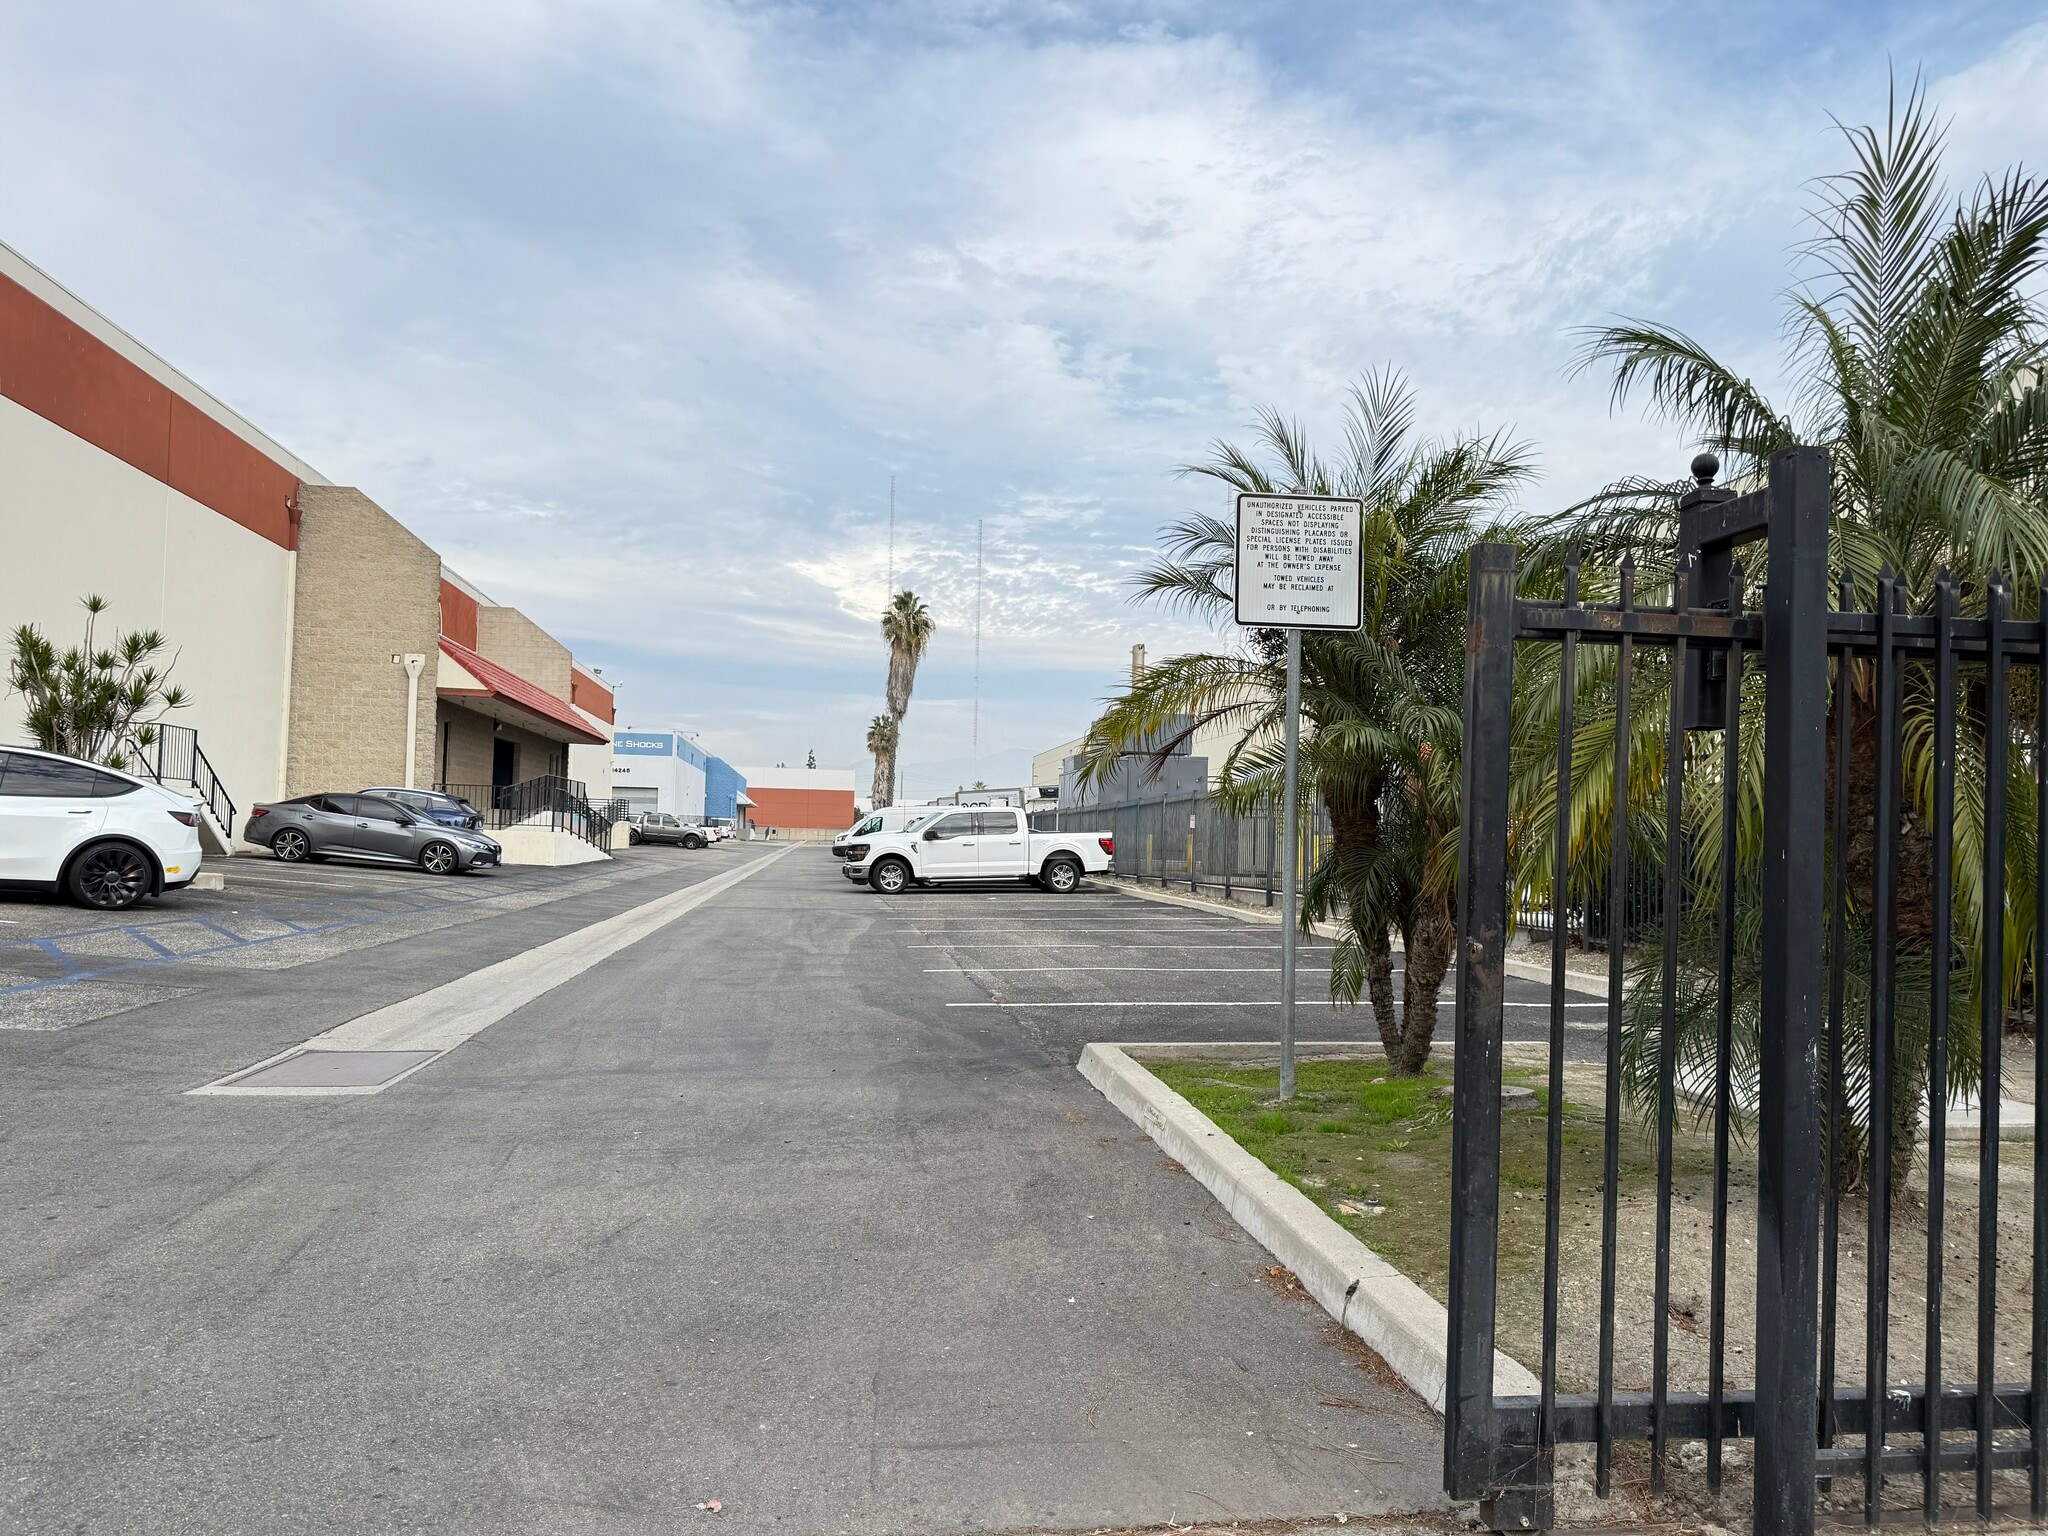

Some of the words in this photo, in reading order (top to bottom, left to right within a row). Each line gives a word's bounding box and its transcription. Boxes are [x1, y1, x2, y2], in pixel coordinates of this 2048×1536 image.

[1247, 502, 1293, 510] UNAUTHORIZED
[1267, 511, 1303, 519] DESIGNATED
[1304, 521, 1339, 529] DISPLAYING
[1251, 527, 1300, 536] DISTINGUISHING
[1305, 529, 1335, 537] PLACARDS
[1313, 547, 1352, 555] DISABILITIES
[1283, 562, 1310, 570] OWNER'S
[1297, 575, 1324, 583] VEHICLES
[1291, 605, 1330, 613] TELEPHONING
